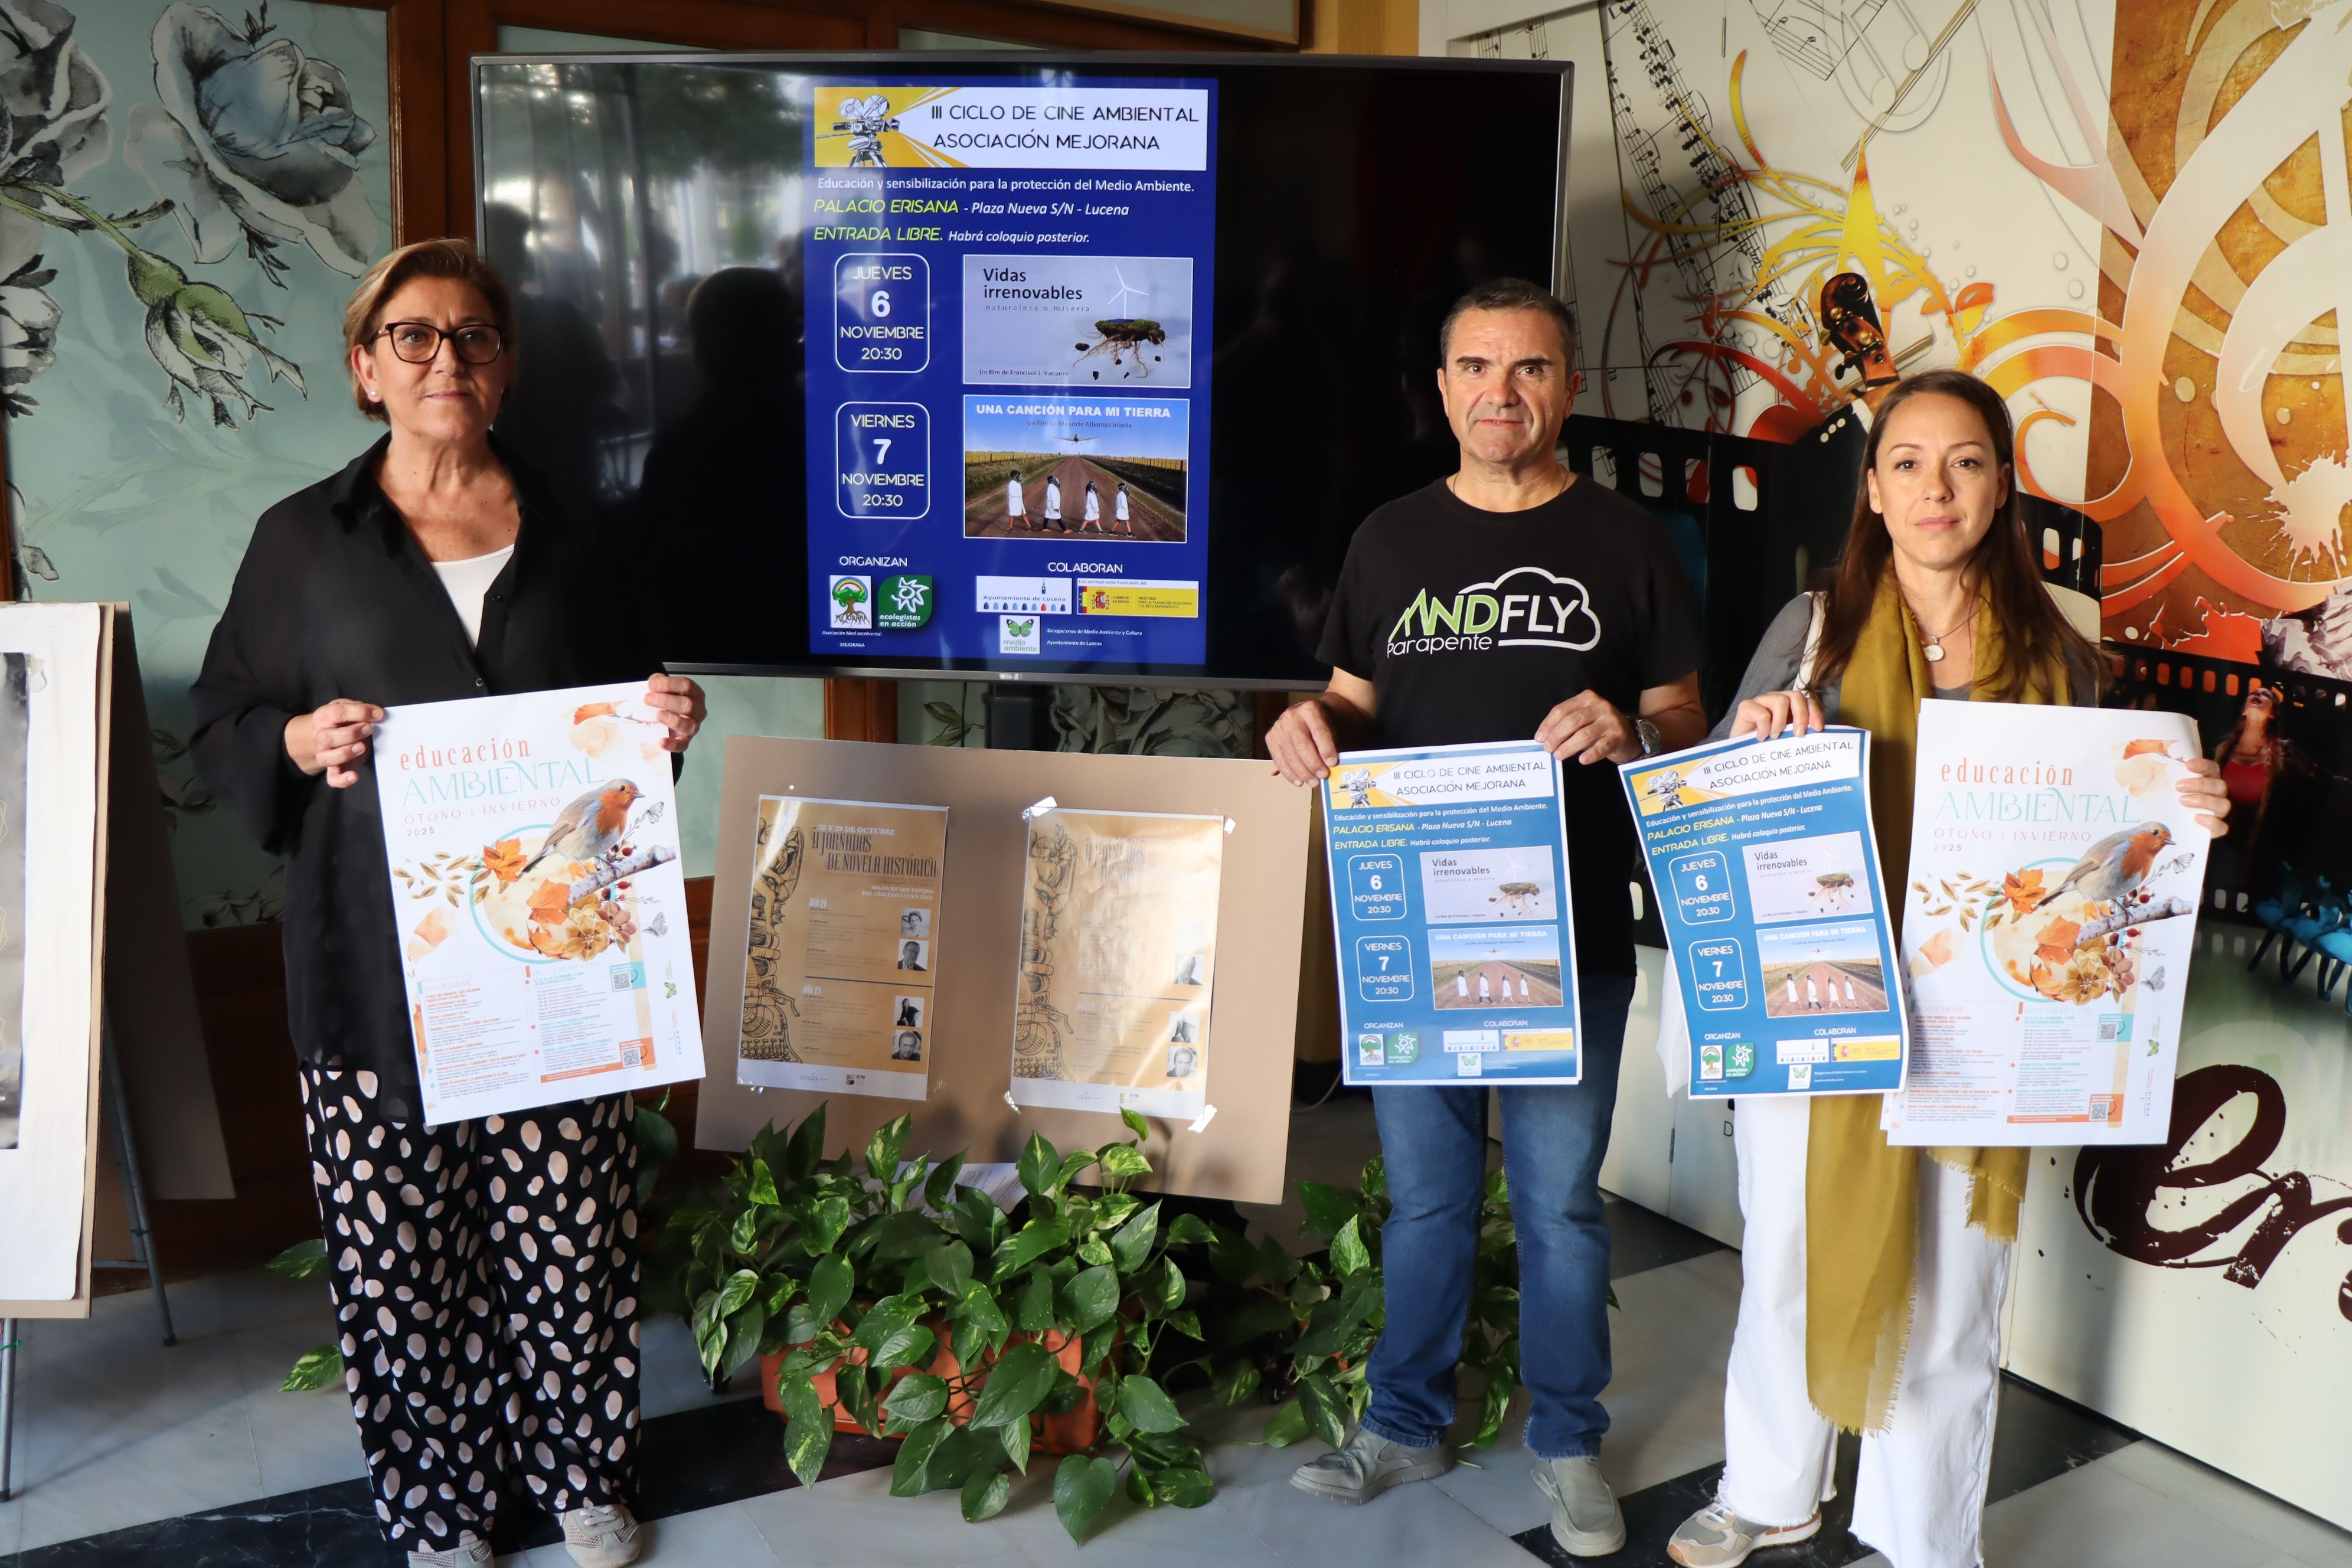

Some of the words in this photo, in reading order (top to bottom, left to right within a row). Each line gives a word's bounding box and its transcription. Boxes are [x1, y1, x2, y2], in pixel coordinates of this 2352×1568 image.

[932, 106, 942, 120] III
[949, 105, 1005, 120] CICLO
[1013, 106, 1037, 120] DE
[1044, 106, 1084, 122] CINE
[1092, 106, 1199, 122] AMBIENTAL
[933, 129, 1049, 149] ASOCIACIÓN
[1057, 134, 1159, 151] MEJORANA
[818, 178, 875, 190] Educación
[877, 181, 884, 191] y
[887, 178, 966, 190] sensibilización
[969, 181, 995, 192] para
[998, 178, 1008, 190] la
[1011, 178, 1071, 193] protección
[1074, 178, 1092, 191] del
[1096, 179, 1132, 191] Medio
[1135, 179, 1194, 192] Ambiente.
[814, 200, 886, 213] PALACIO
[890, 200, 959, 214] ERISANA
[972, 202, 1004, 216] Plaza
[1008, 203, 1047, 215] Nueva
[1051, 203, 1073, 216] S/N
[1086, 204, 1129, 215] Lucena
[814, 228, 891, 241] ENTRADA
[897, 228, 943, 241] LIBRE.
[949, 231, 983, 243] Habrá
[986, 231, 1033, 245] coloquio
[1037, 231, 1089, 244] posterior.
[852, 266, 912, 280] JUEVES
[983, 267, 1027, 282] Vidas
[984, 285, 1083, 300] irrenovables
[871, 292, 890, 316] 6
[841, 326, 924, 339] NOVIEMBRE
[861, 348, 902, 360] 20:30
[976, 404, 1002, 414] UNA
[1007, 404, 1064, 415] CANCIÓN
[1069, 406, 1102, 416] PARA
[1106, 407, 1119, 416] MI
[1124, 407, 1171, 417] TIERRA
[851, 414, 914, 429] VIERNES
[874, 439, 891, 464] 7
[842, 473, 925, 486] NOVIEMBRE
[863, 494, 903, 507] 20:30
[839, 556, 907, 567] ORGANIZAN
[1048, 561, 1123, 573] COLABORAN
[400, 737, 530, 770] educación
[1714, 757, 1748, 772] CICLO
[1752, 753, 1767, 763] DE
[1770, 750, 1792, 762] CINE
[1795, 741, 1854, 757] AMBIENTAL
[1404, 770, 1435, 779] CICLO
[1440, 768, 1454, 777] DE
[1458, 766, 1481, 776] CINE
[1485, 762, 1547, 773] AMBIENTAL
[1710, 767, 1777, 789] ASOCIACIÓN
[1779, 760, 1831, 776] MEJORANA
[1942, 757, 2073, 785] educación
[402, 758, 605, 806] AMBIENTAL
[1396, 781, 1462, 795] ASOCIACIÓN
[1466, 779, 1526, 791] MEJORANA
[405, 809, 462, 825] OTOÑO
[483, 797, 560, 815] INVIERNO
[1936, 787, 2140, 823] AMBIENTAL
[407, 827, 435, 837] 2025
[1935, 827, 1991, 840] OTOÑO
[2014, 831, 2090, 841] INVIERNO
[821, 832, 871, 855] JORNADAS
[1432, 858, 1457, 867] Vidas
[1755, 850, 1778, 861] Vidas
[828, 852, 841, 870] DE
[844, 854, 880, 873] NOVELA
[884, 854, 937, 877] HISTÓRICA
[1359, 861, 1393, 870] JUEVES
[1433, 866, 1490, 876] irrenovables
[1681, 858, 1716, 872] JUEVES
[1756, 857, 1808, 871] irrenovables
[1371, 875, 1381, 890] 6
[1696, 874, 1708, 891] 6
[1355, 893, 1402, 902] NOVIEMBRE
[1681, 892, 1729, 906] NOVIEMBRE
[1368, 906, 1391, 914] 20:30
[1696, 907, 1720, 917] 20:30
[1365, 942, 1402, 950] VIERNES
[1697, 946, 1733, 957] VIERNES
[1378, 956, 1390, 971] 7
[1712, 961, 1723, 977] 7
[424, 979, 473, 992] NOVIEMBRE
[1363, 975, 1410, 984] NOVIEMBRE
[1699, 981, 1743, 991] NOVIEMBRE
[1712, 994, 1733, 1003] 20:30
